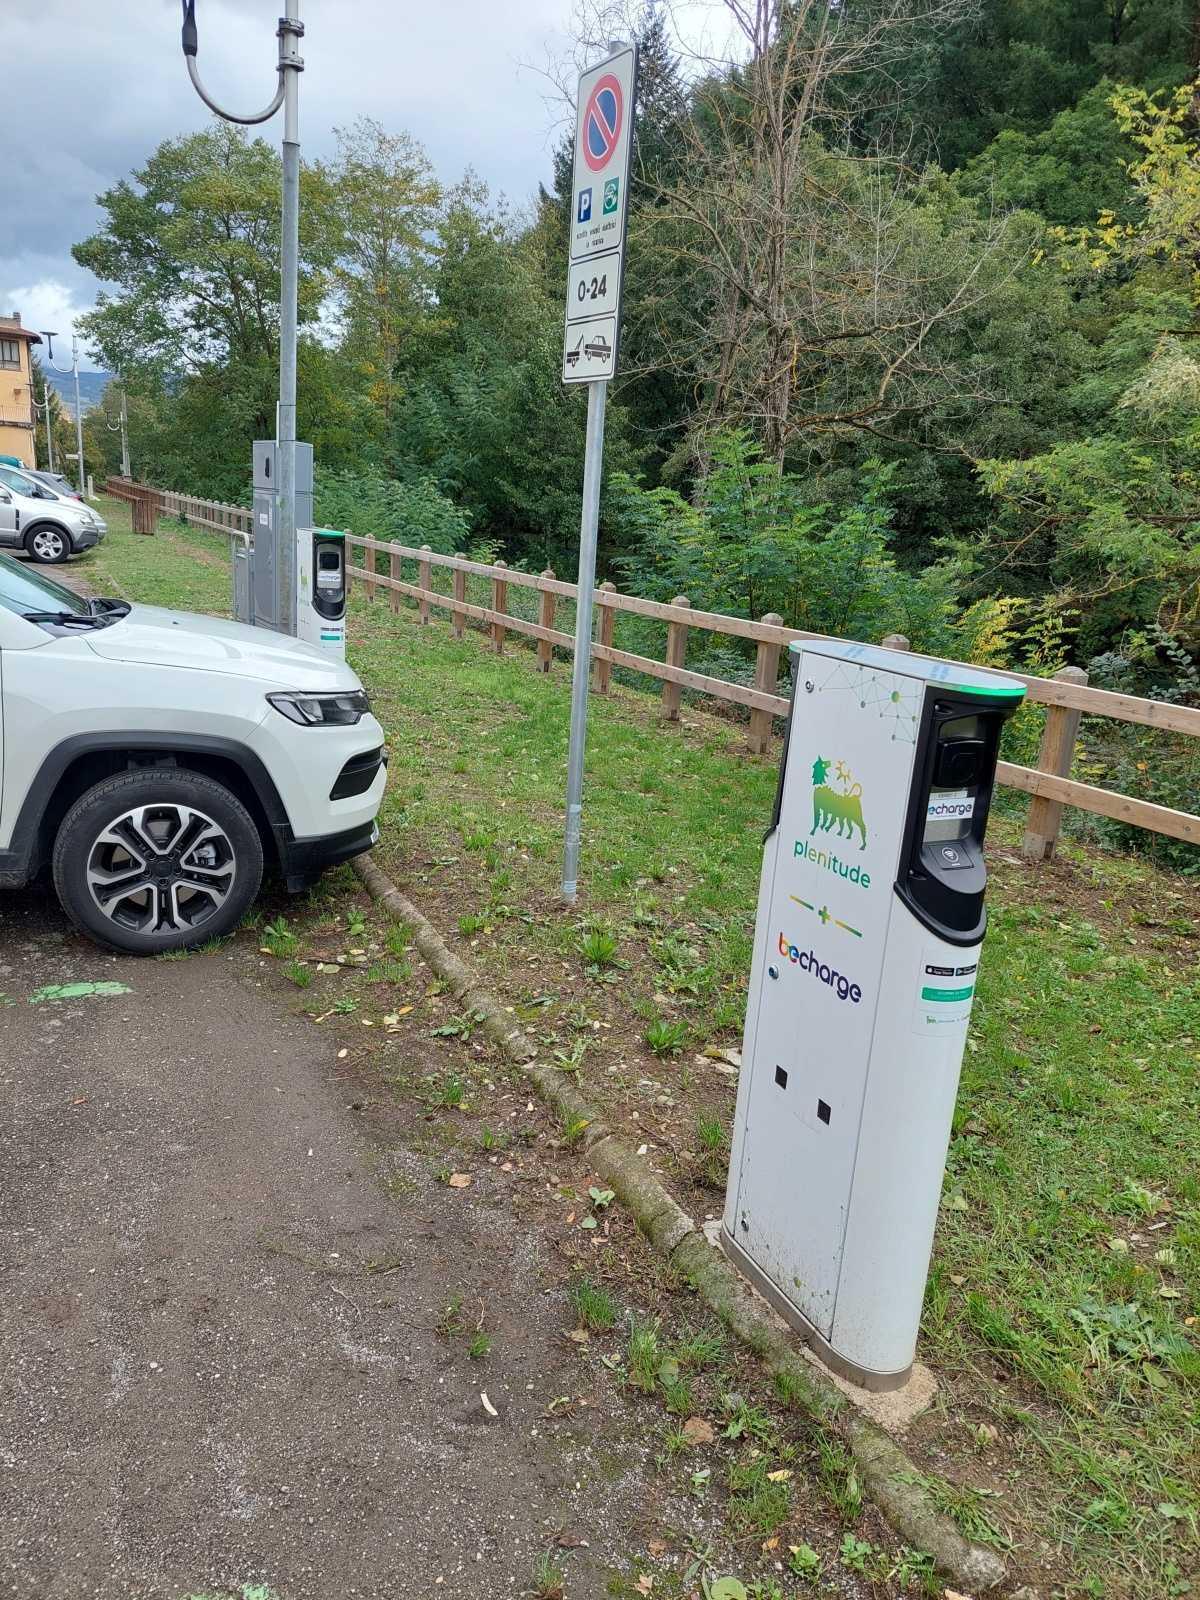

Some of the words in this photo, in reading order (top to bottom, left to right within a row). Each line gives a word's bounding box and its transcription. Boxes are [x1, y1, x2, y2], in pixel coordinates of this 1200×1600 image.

[580, 193, 590, 220] P
[578, 274, 607, 302] 0-24
[928, 803, 972, 816] echarge
[794, 840, 871, 888] plenitude
[779, 932, 862, 1003] becharge
